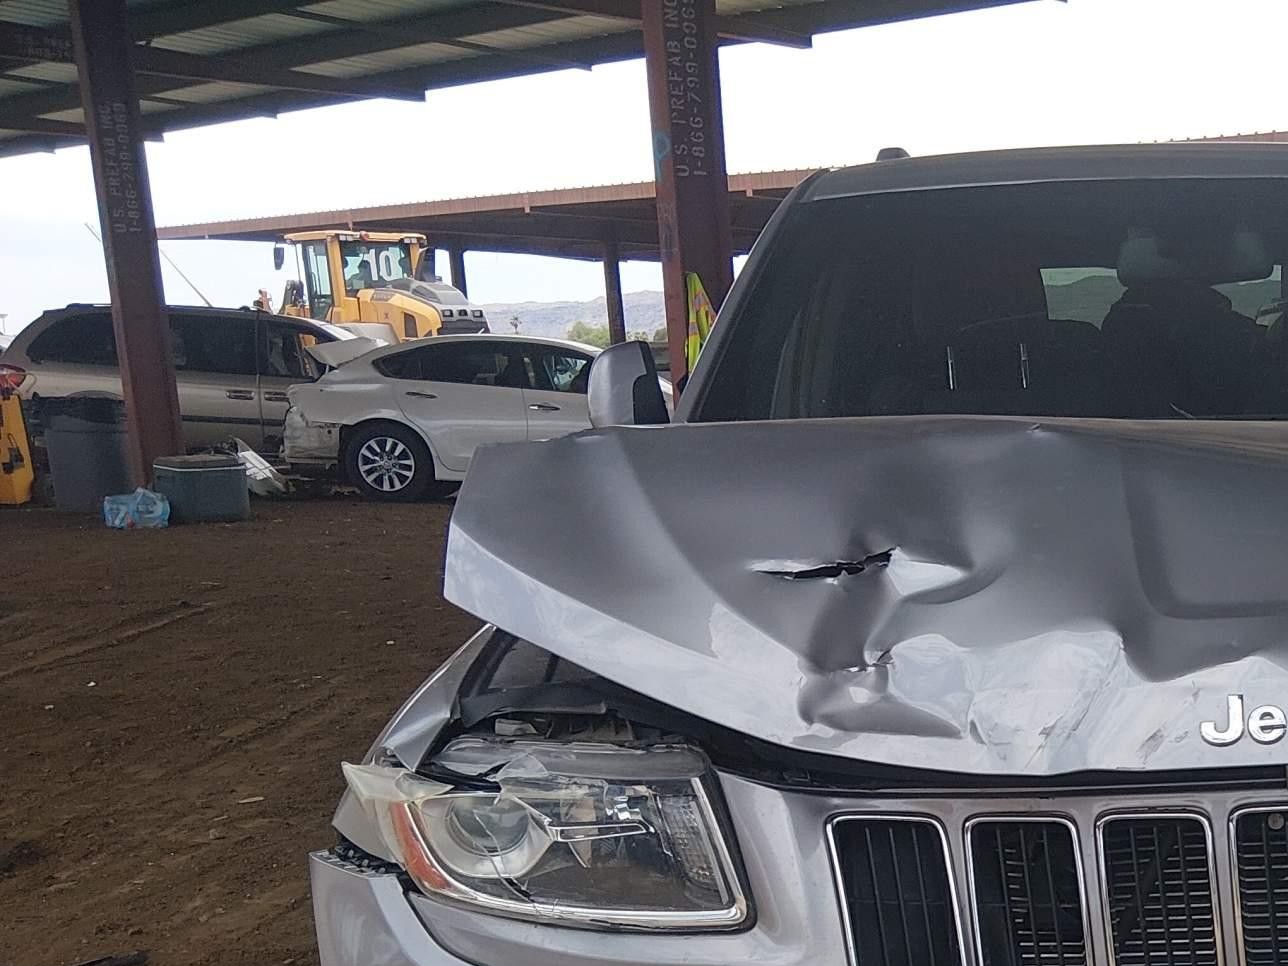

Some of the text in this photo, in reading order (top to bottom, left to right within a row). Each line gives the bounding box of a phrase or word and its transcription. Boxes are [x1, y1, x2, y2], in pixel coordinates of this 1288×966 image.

[667, 41, 687, 124] PREFAB
[675, 138, 690, 177] U.S.
[363, 248, 397, 282] 10
